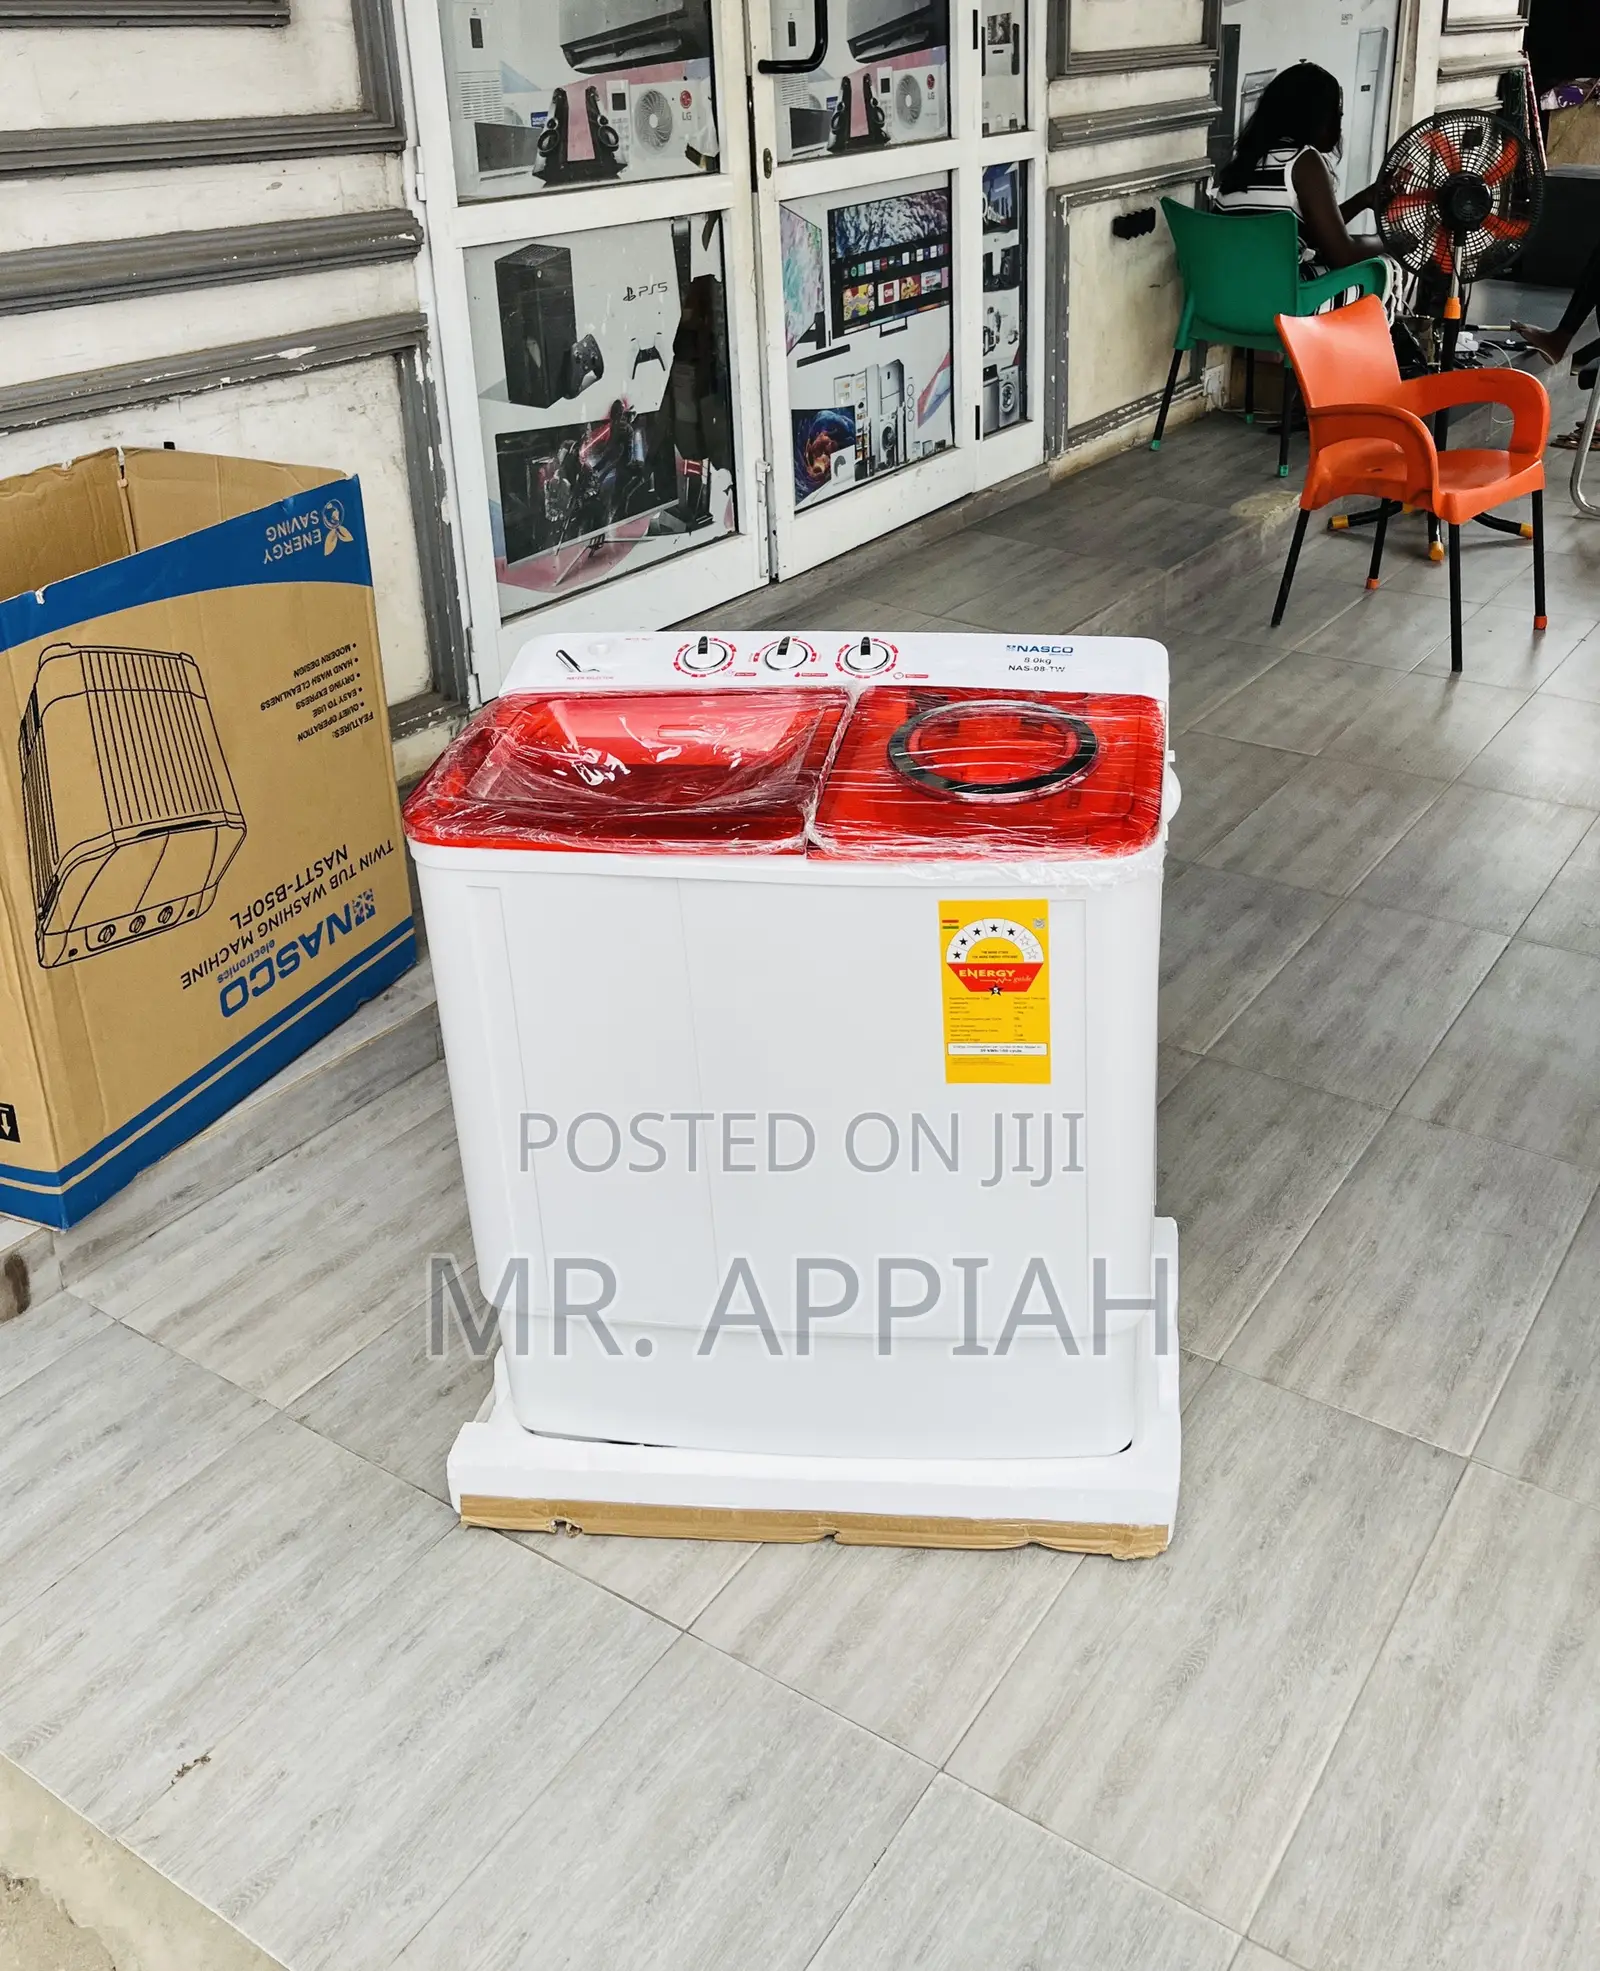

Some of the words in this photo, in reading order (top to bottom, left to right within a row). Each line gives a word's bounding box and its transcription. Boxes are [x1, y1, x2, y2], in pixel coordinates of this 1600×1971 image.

[927, 91, 935, 100] LG
[681, 111, 692, 121] LG
[638, 281, 668, 297] PS5
[265, 510, 320, 542] SAVING
[263, 528, 322, 565] ENERGY
[321, 643, 351, 665] MODERN
[1017, 645, 1074, 654] NASCO
[293, 658, 320, 678] DESIGN
[332, 658, 354, 674] HAND
[311, 669, 333, 686] WASH
[329, 673, 356, 692] DRYING
[260, 681, 311, 711] CLEANLINESS
[295, 687, 328, 710] EXPRESS
[327, 698, 338, 709] TO
[339, 688, 358, 704] EASY
[312, 705, 327, 718] USE
[338, 703, 360, 720] QUIET
[296, 714, 338, 742] OPERATION
[332, 711, 374, 738] FEATURES:
[360, 839, 394, 872] TWIN
[330, 863, 357, 890] TUB
[257, 883, 328, 938] WASHING
[180, 931, 254, 990] MACHINE
[217, 939, 276, 984] electronics
[219, 903, 353, 1018] NASCO
[959, 968, 1016, 979] ENERGY
